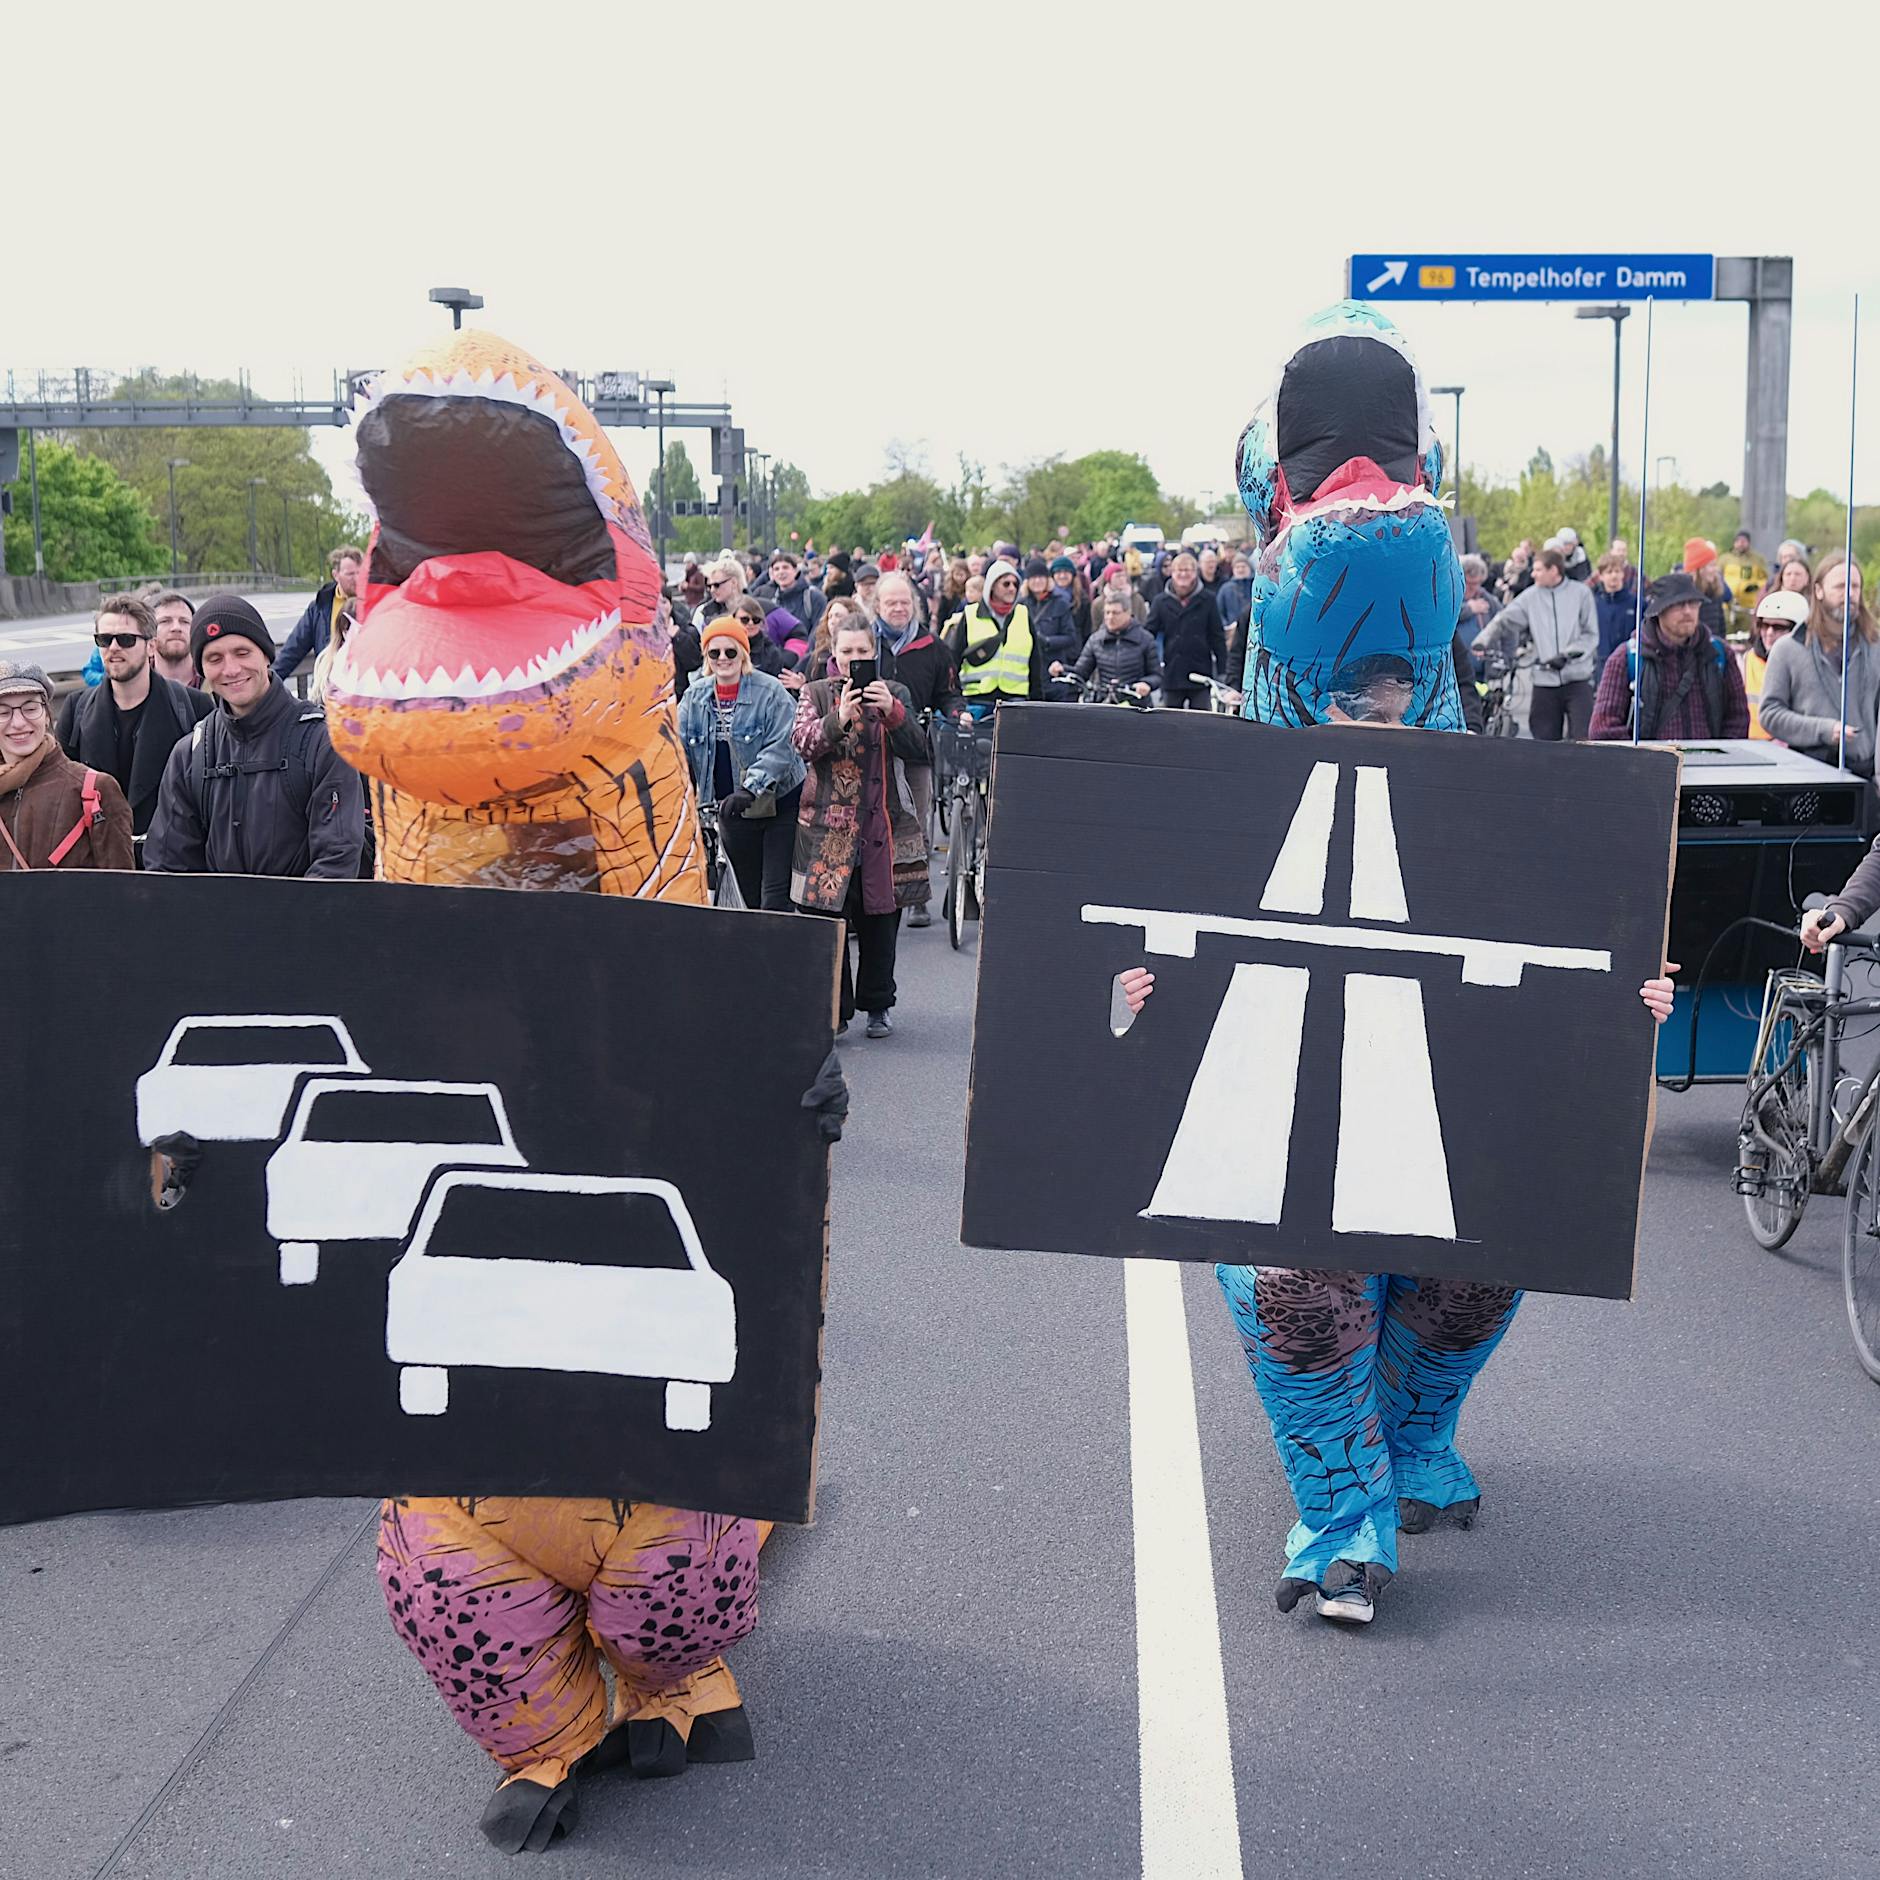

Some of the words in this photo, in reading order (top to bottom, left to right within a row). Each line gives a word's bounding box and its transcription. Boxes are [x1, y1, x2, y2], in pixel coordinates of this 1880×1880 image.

[1428, 270, 1446, 284] 96
[1466, 267, 1606, 292] Tempelhofer
[1616, 267, 1686, 287] Damm
